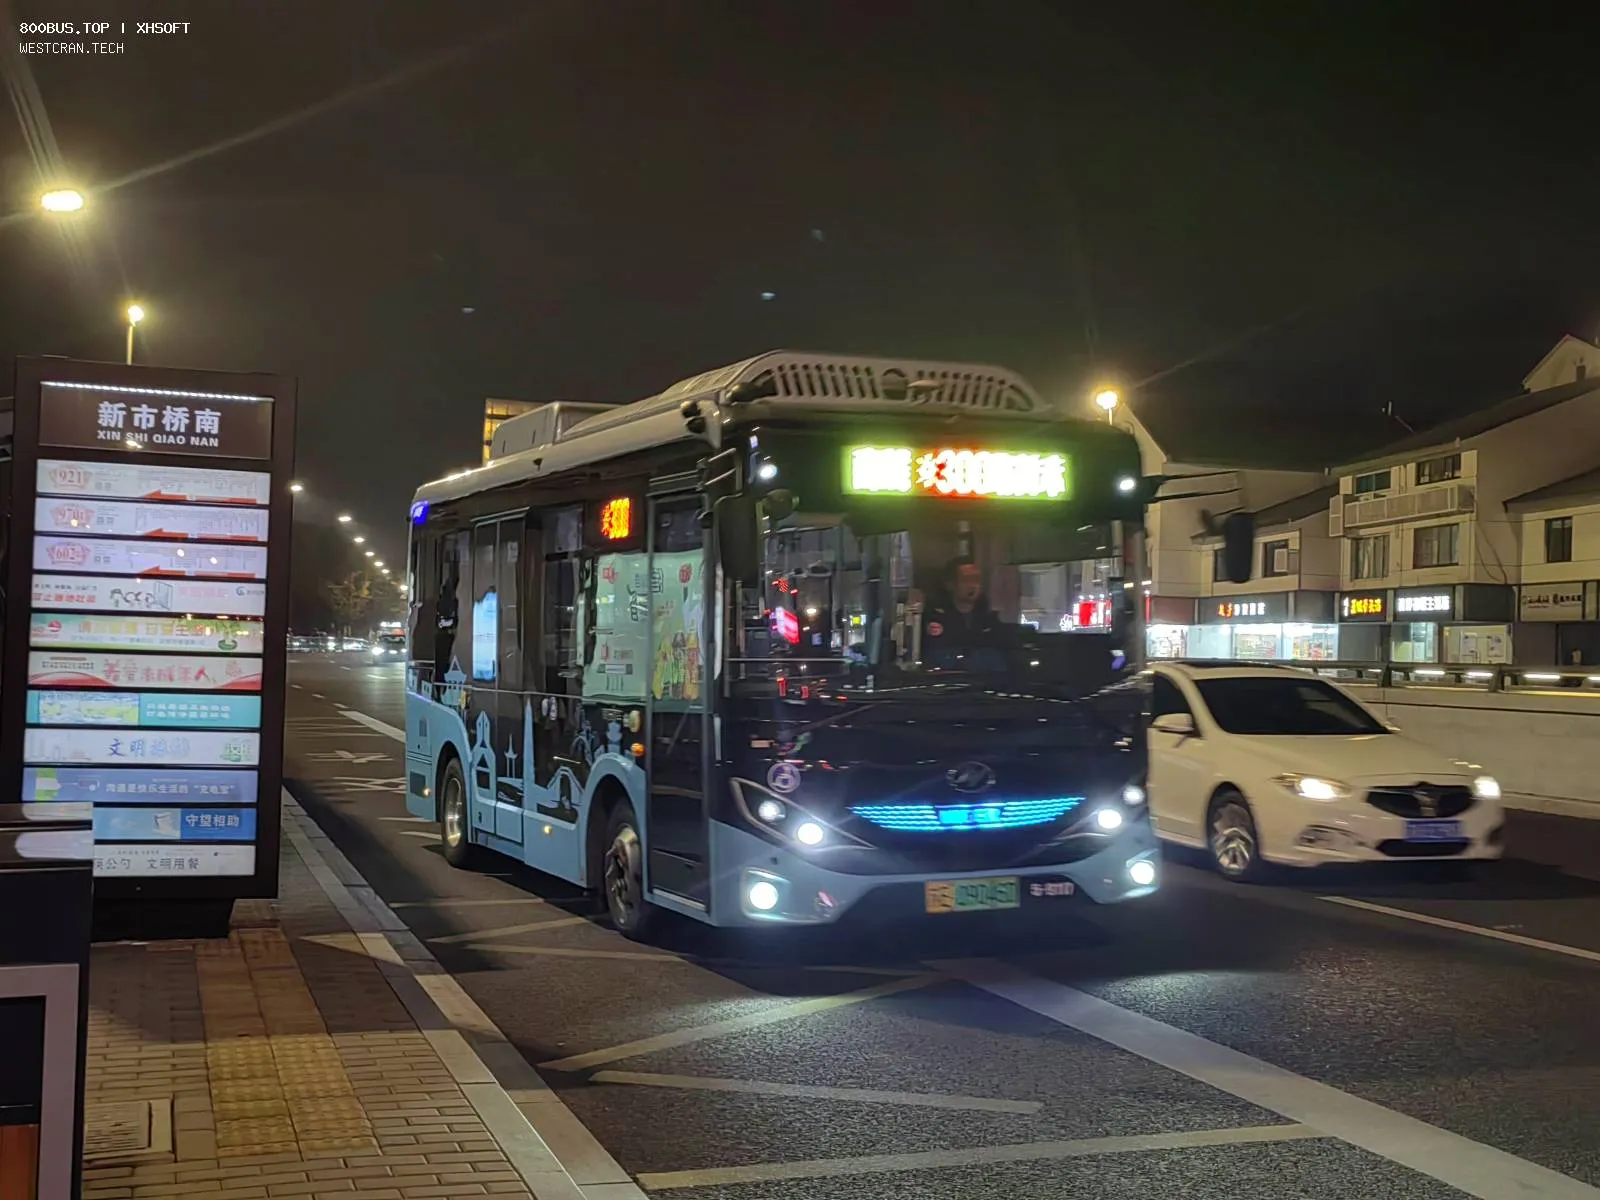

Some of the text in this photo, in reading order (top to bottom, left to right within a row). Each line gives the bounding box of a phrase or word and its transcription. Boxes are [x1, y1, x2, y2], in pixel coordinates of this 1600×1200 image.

[97, 401, 222, 434] 新市桥南
[97, 430, 219, 448] XIN SHI QIAO NAN
[58, 469, 83, 484] 921
[185, 813, 240, 828] 守望相助
[147, 857, 201, 870] 文明用餐
